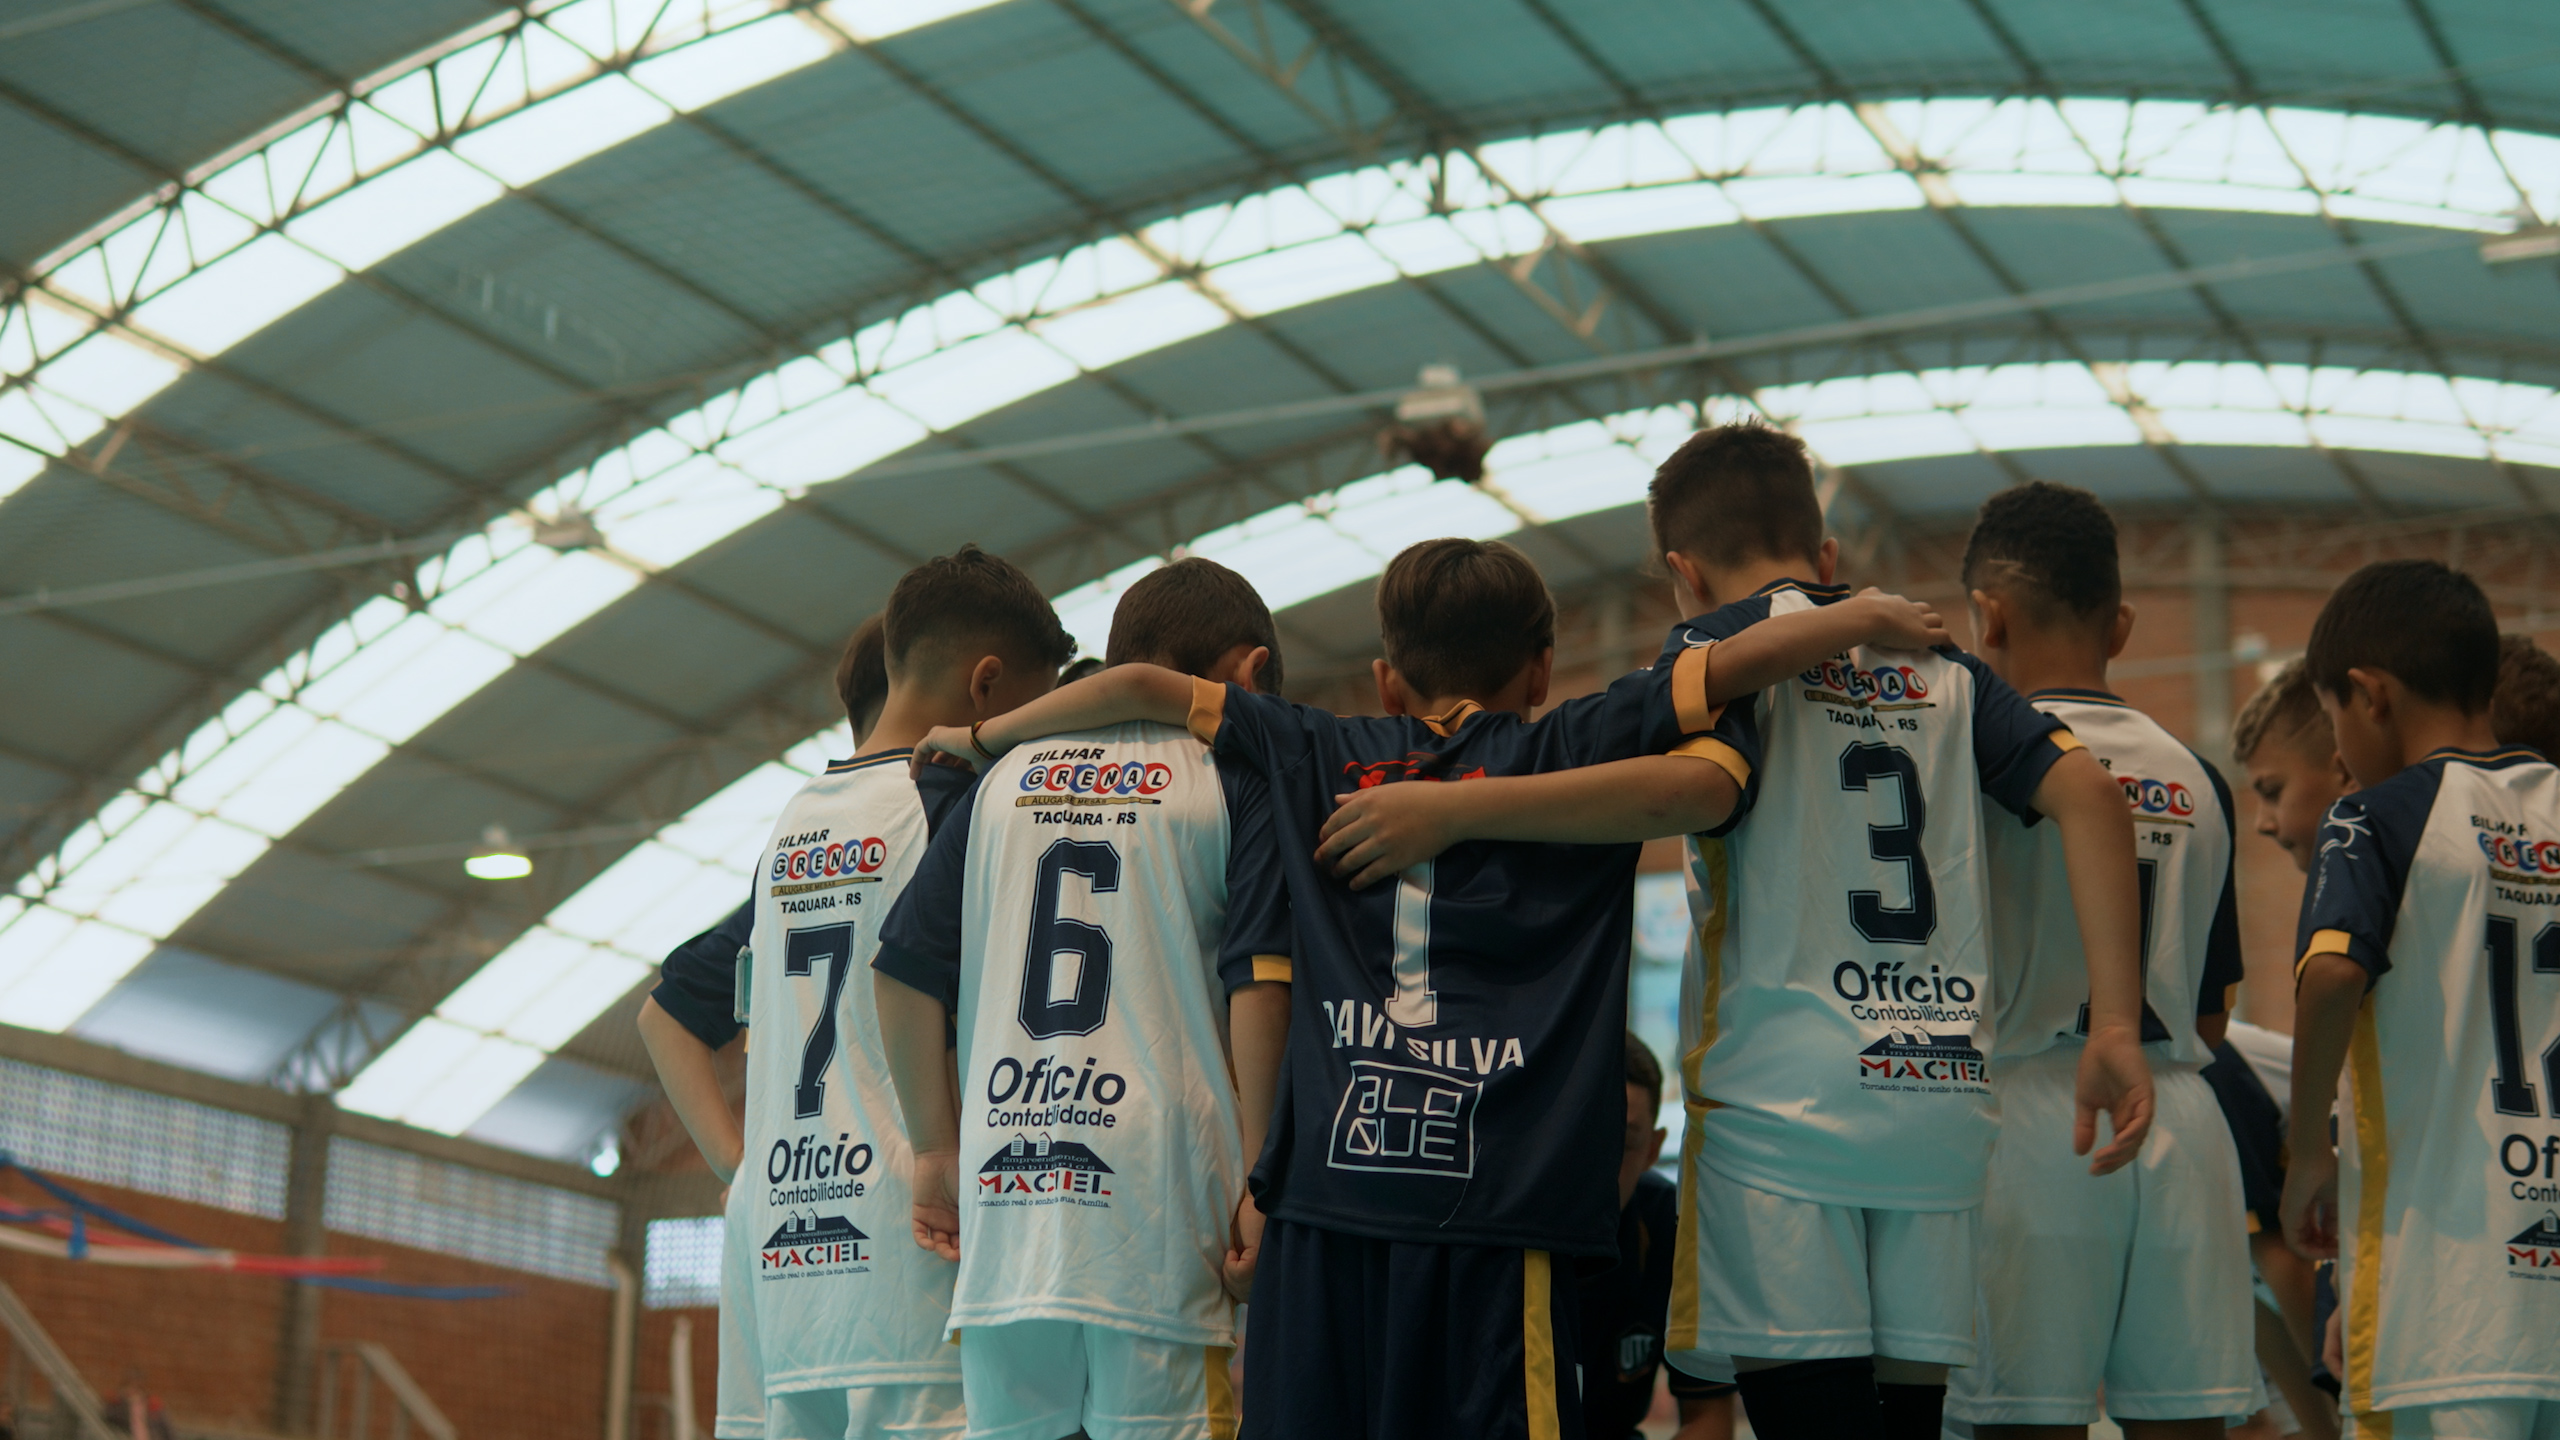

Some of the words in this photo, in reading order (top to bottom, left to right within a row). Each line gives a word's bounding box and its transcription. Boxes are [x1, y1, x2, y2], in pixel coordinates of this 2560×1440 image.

[1897, 718, 1918, 731] RS
[1029, 748, 1105, 765] BILHAR
[1025, 766, 1166, 790] GRENAL
[1033, 810, 1103, 826] TAQUARA
[1116, 812, 1137, 825] RS
[776, 828, 830, 851] BILHAR
[1839, 741, 1937, 945] 3
[2151, 831, 2173, 846] RS
[773, 843, 882, 877] GRENAL
[781, 895, 836, 914] TAQUARA
[845, 892, 862, 906] RS
[1017, 837, 1121, 1041] 6
[1833, 960, 1976, 1004] Ofício
[785, 921, 855, 1119] 7
[1851, 1003, 1981, 1023] Contabilidade
[1406, 1037, 1525, 1075] SILVA
[987, 1054, 1127, 1106] Ofício
[1859, 1057, 1991, 1083] MACIEL
[1902, 1084, 1919, 1092] real
[768, 1133, 873, 1185] Ofício
[769, 1179, 865, 1207] Contabilidade
[978, 1170, 1112, 1196] MACIEL
[1011, 1198, 1027, 1207] real
[762, 1242, 870, 1270] MACIEL
